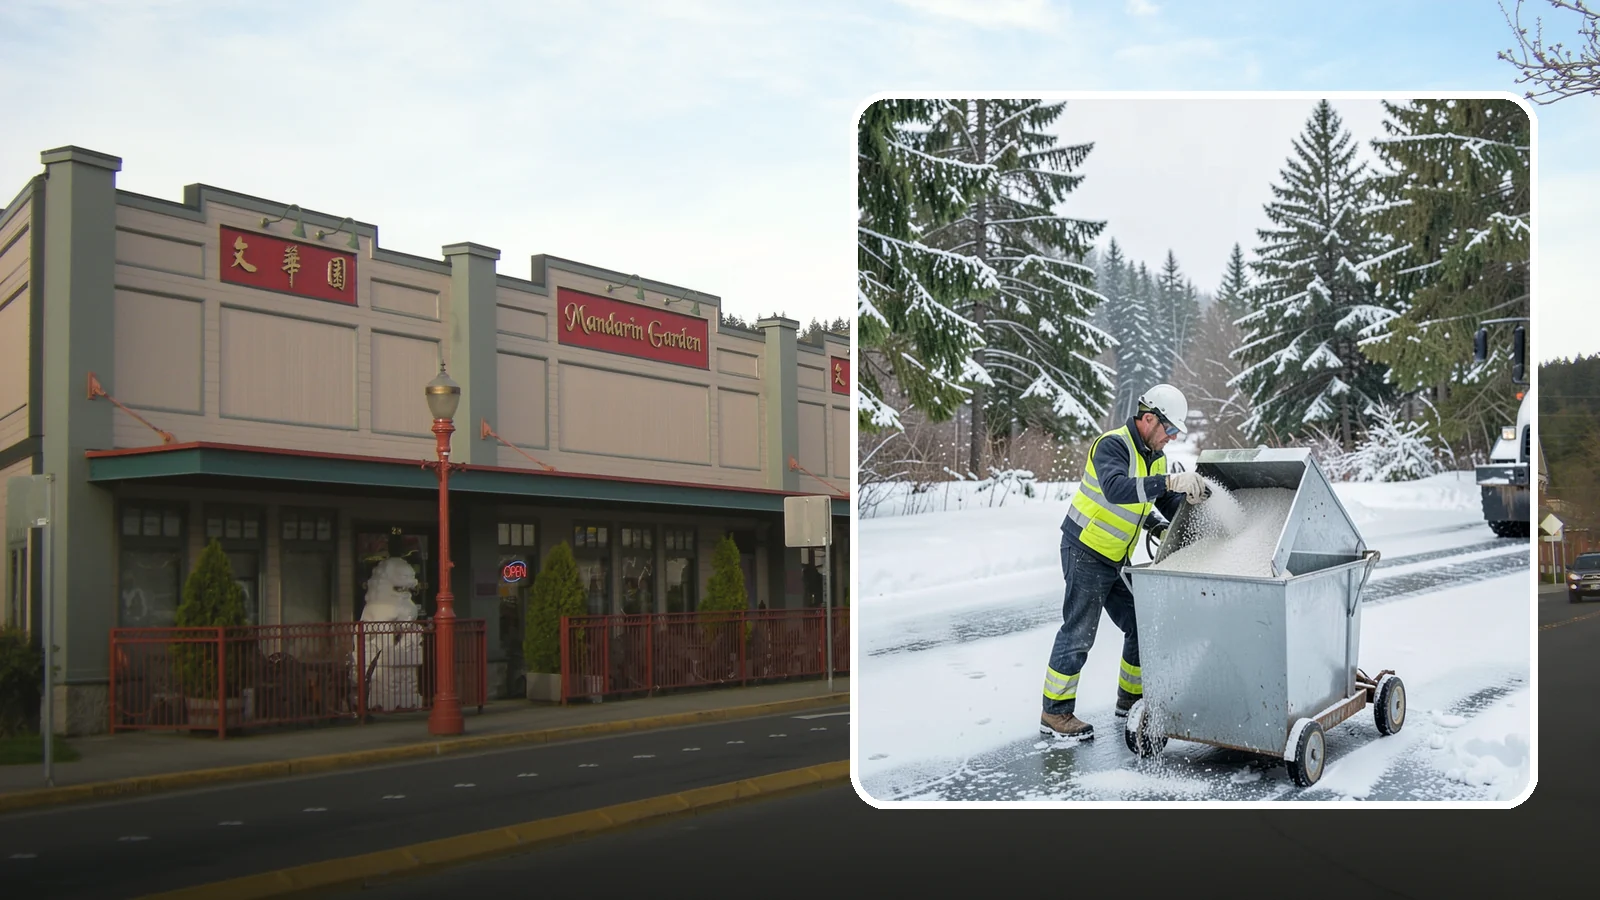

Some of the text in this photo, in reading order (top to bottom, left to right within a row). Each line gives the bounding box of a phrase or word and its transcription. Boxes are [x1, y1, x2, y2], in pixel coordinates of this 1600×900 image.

[230, 235, 346, 291] 文華園
[564, 302, 701, 352] Mandarin Garden
[503, 565, 527, 578] OPEN
